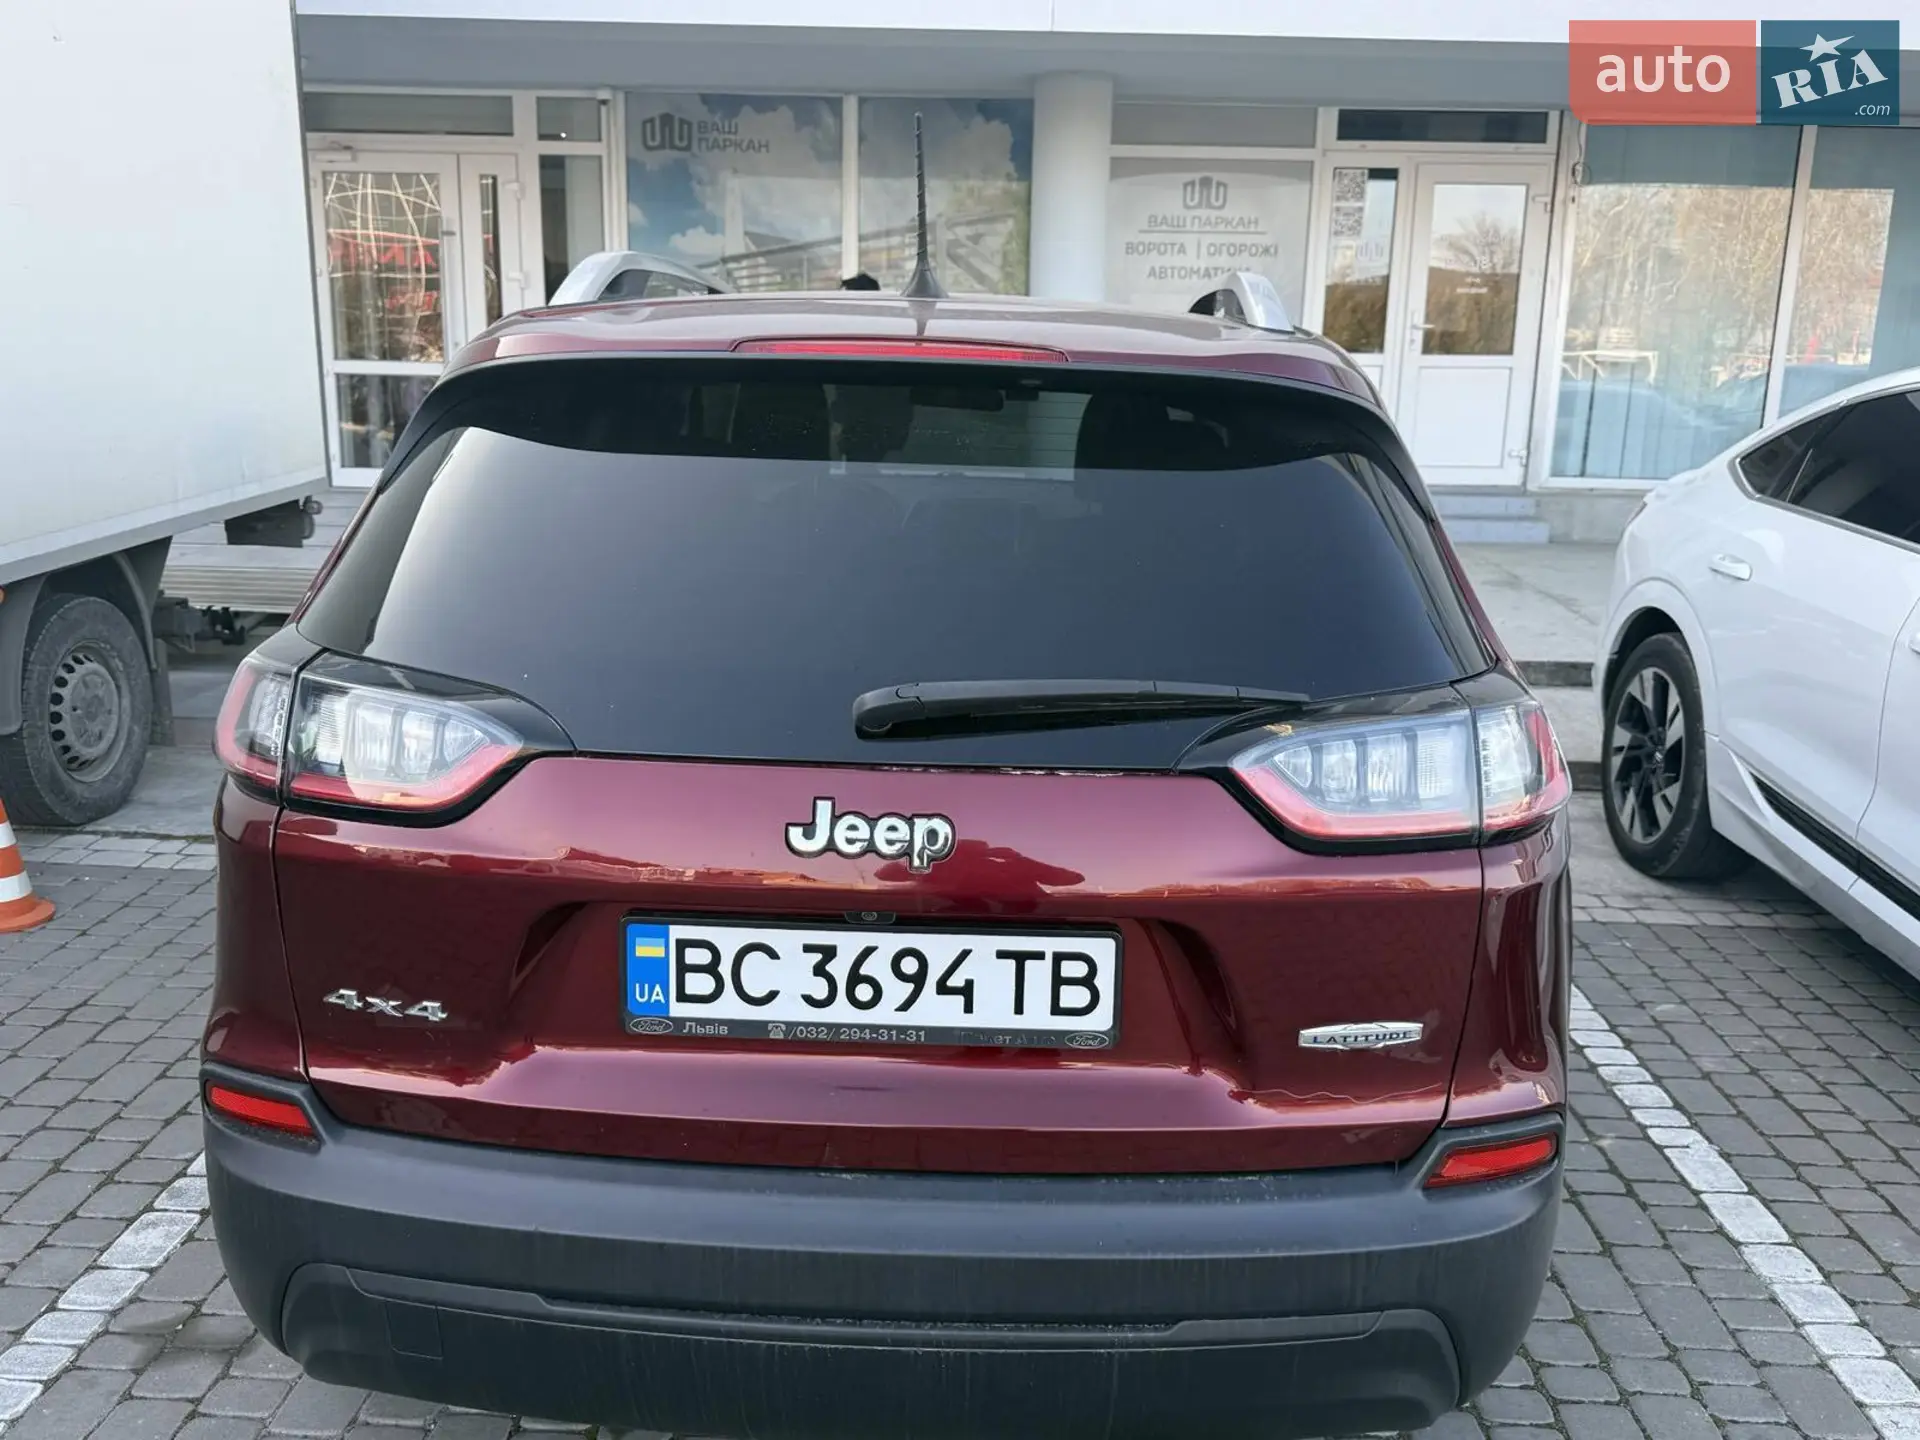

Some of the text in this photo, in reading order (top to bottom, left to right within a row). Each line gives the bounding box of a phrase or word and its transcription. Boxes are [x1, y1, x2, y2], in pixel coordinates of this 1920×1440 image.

[697, 120, 738, 136] ВАШ
[697, 137, 770, 153] ПАРКАН
[1148, 214, 1259, 230] ВАШ ПАРКАН
[1125, 241, 1279, 258] ВОРОТА ОГОРОЖІ
[787, 798, 955, 870] Jeep
[675, 938, 1100, 1016] BC 3694 TB
[635, 983, 665, 1003] UA
[637, 1019, 666, 1033] Ford
[683, 1021, 729, 1035] Львів
[839, 1027, 926, 1042] 294-31-31
[1312, 1030, 1414, 1044] LATITUDE
